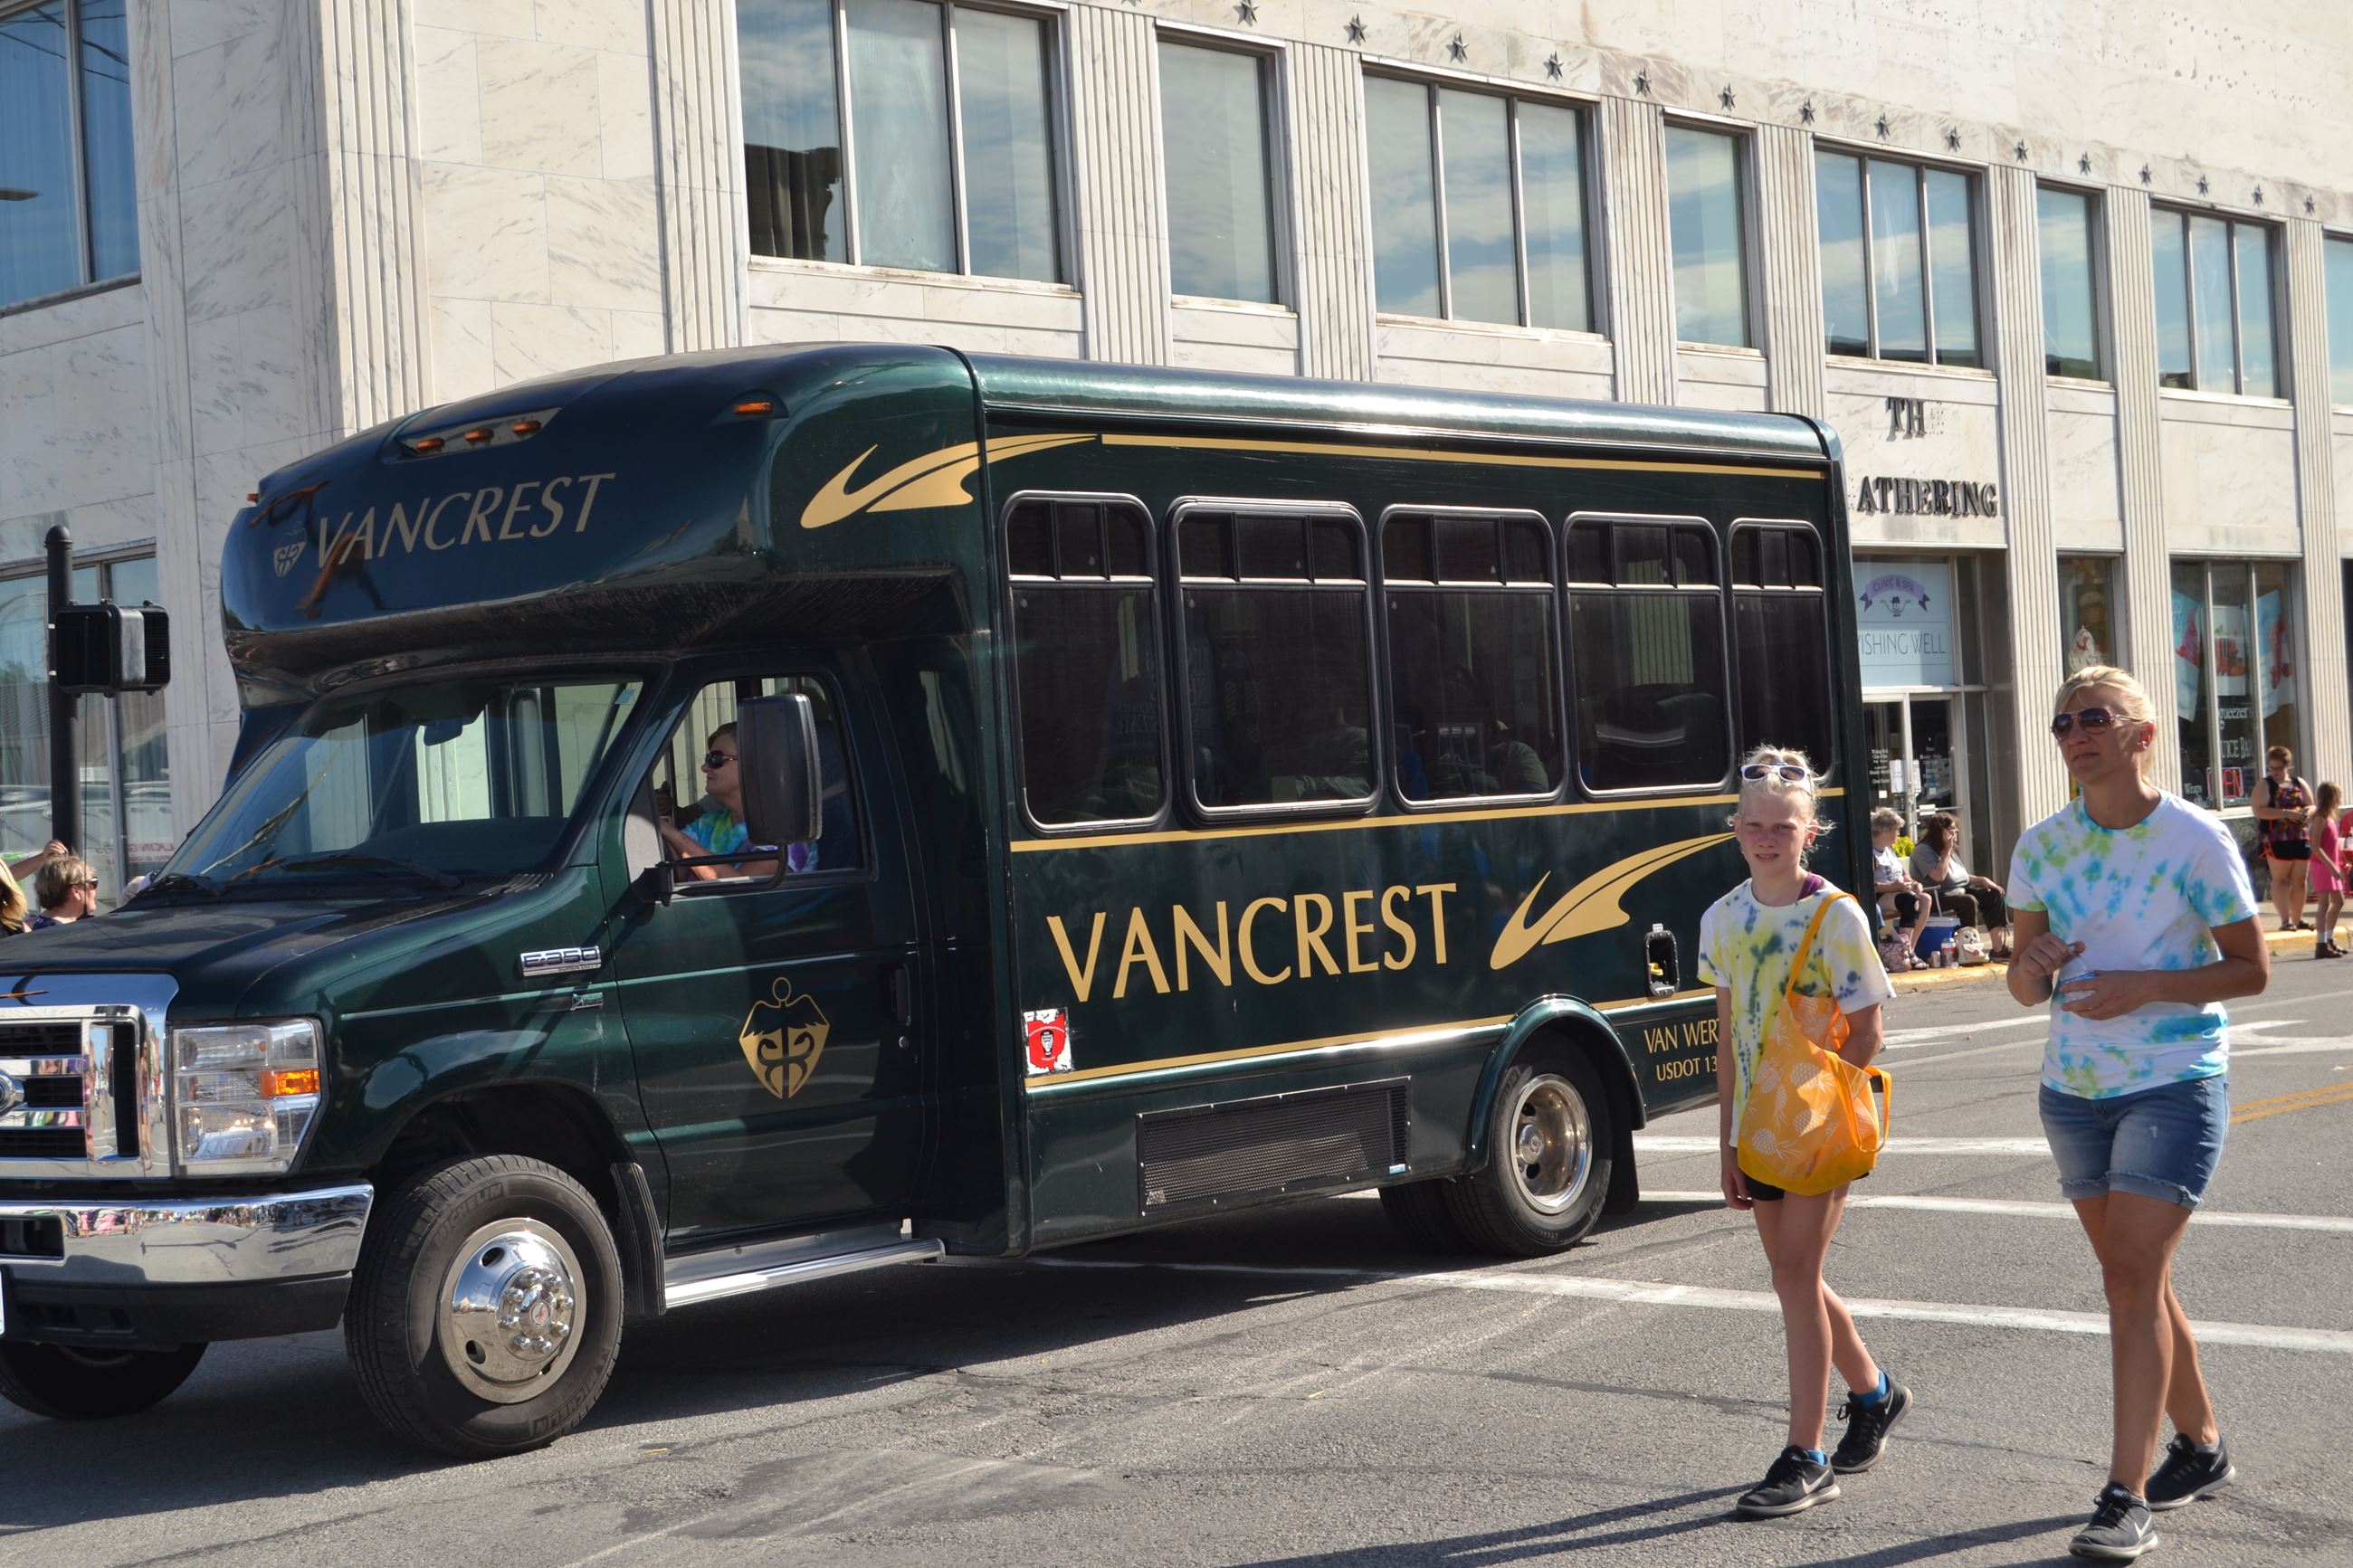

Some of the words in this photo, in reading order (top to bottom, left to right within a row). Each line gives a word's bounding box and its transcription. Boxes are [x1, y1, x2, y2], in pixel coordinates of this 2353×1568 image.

[1858, 476, 1997, 518] ATHERING
[317, 471, 616, 568] VANCREST
[1873, 577, 1895, 592] CLINIC
[1895, 578, 1900, 587] &
[1902, 578, 1915, 592] SPA
[1910, 633, 1946, 654] WELL
[2220, 739, 2239, 758] UICE
[1046, 882, 1456, 1002] VANCREST
[1644, 1024, 1678, 1054] VAN
[1656, 1058, 1700, 1081] USDOT
